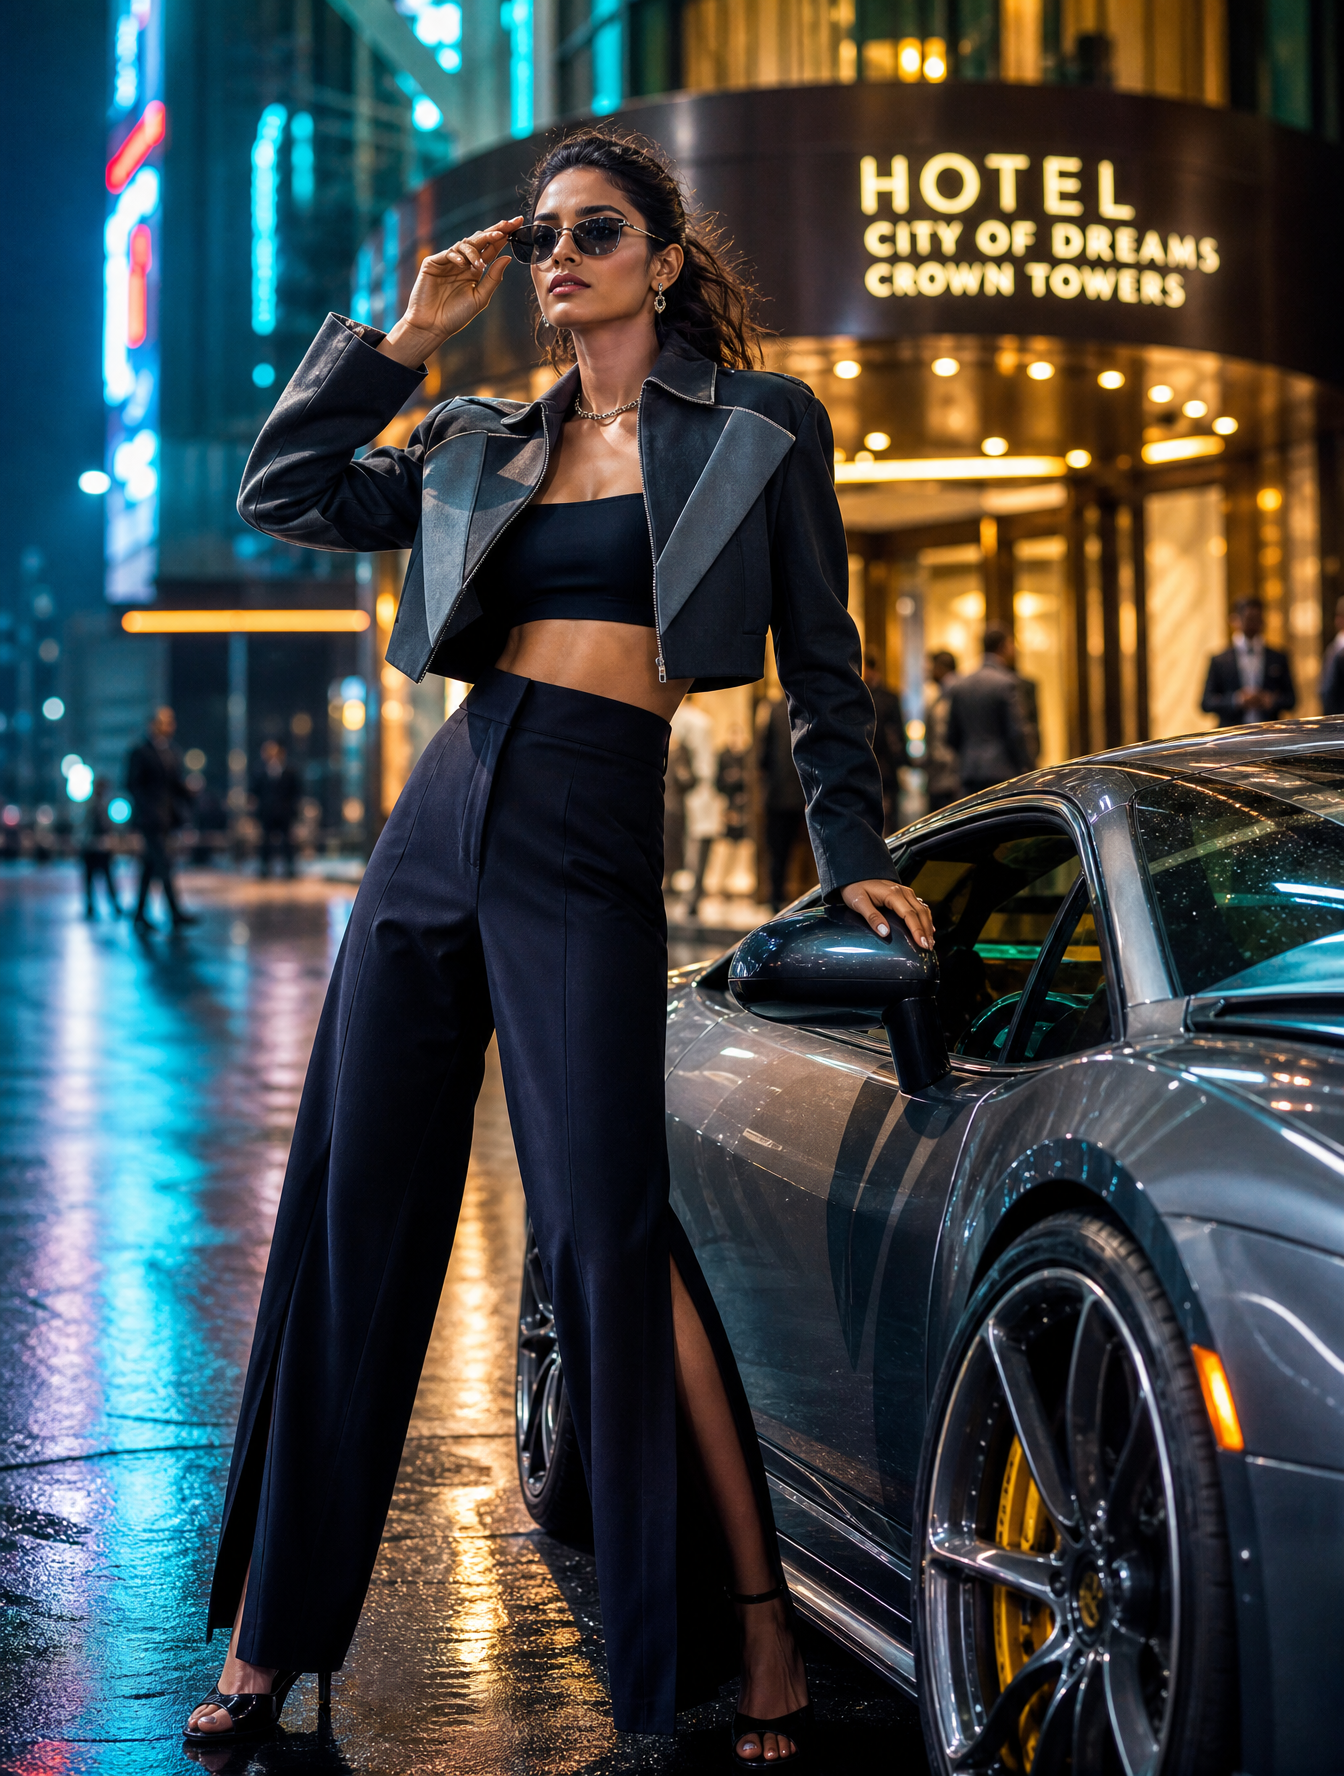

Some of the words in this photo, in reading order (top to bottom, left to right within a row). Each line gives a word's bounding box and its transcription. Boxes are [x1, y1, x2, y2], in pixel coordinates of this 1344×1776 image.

[860, 152, 1136, 221] HOTEL
[864, 220, 964, 258] CITY
[975, 219, 1037, 257] OF
[1051, 222, 1220, 274] DREAMS
[864, 261, 1015, 298] CROWN
[1024, 262, 1186, 308] TOWERS
